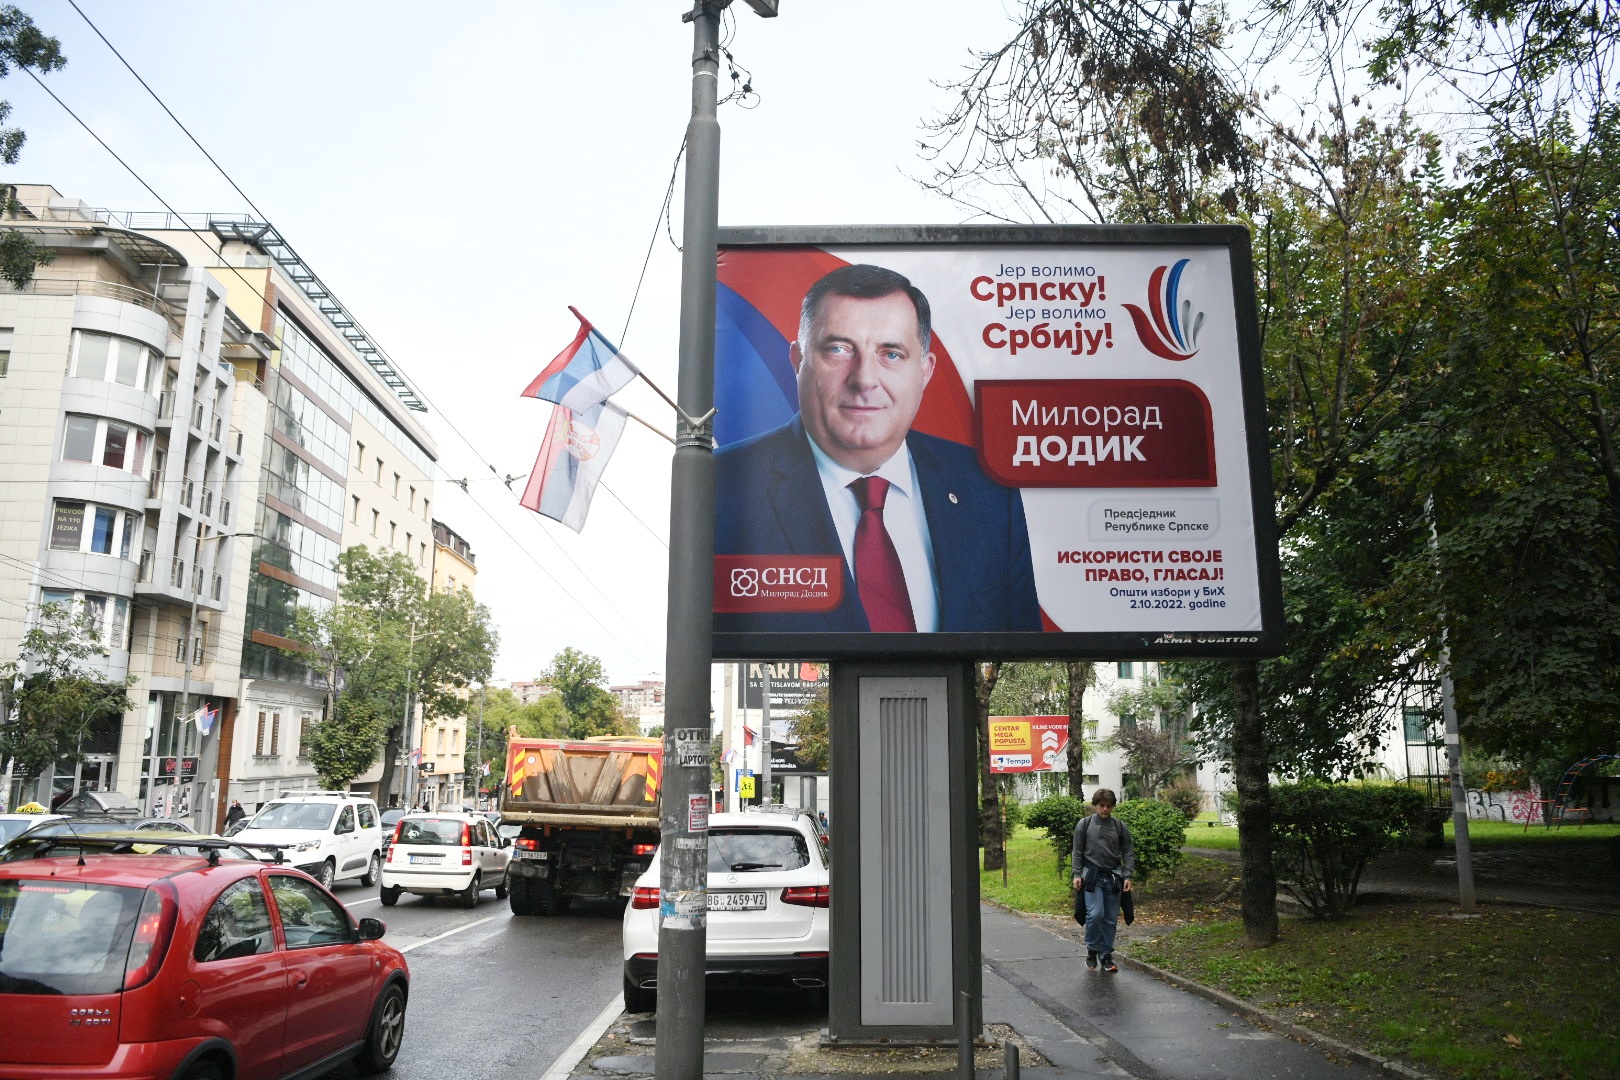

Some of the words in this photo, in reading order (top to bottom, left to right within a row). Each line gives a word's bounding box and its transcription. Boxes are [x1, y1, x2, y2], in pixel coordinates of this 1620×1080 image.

[996, 264, 1026, 279] Јер
[1032, 267, 1096, 277] волимо
[970, 275, 1106, 307] Српску!
[1005, 306, 1036, 322] Јер
[1041, 309, 1106, 319] волимо
[982, 322, 1114, 355] Србију!
[1011, 400, 1163, 432] Милорад
[1012, 435, 1147, 466] ДОДИК
[1104, 509, 1176, 520] Предсједник
[1105, 522, 1165, 533] Републике
[1168, 522, 1209, 531] Српске
[1057, 550, 1164, 564] ИСКОРИСТИ
[1168, 550, 1222, 563] СВОЈЕ
[761, 567, 828, 589] СНСД
[1085, 569, 1149, 583] ПРАВО,
[1154, 568, 1224, 582] ГЛАСАЈ!
[761, 590, 799, 599] Милорад
[801, 590, 828, 598] Додик
[1110, 587, 1148, 597] Општи
[1151, 588, 1191, 597] избори
[1193, 589, 1200, 598] у
[1203, 587, 1225, 596] БиХ
[1130, 600, 1186, 609] 2.10.2022.
[1189, 599, 1226, 610] godine
[707, 895, 719, 905] BG
